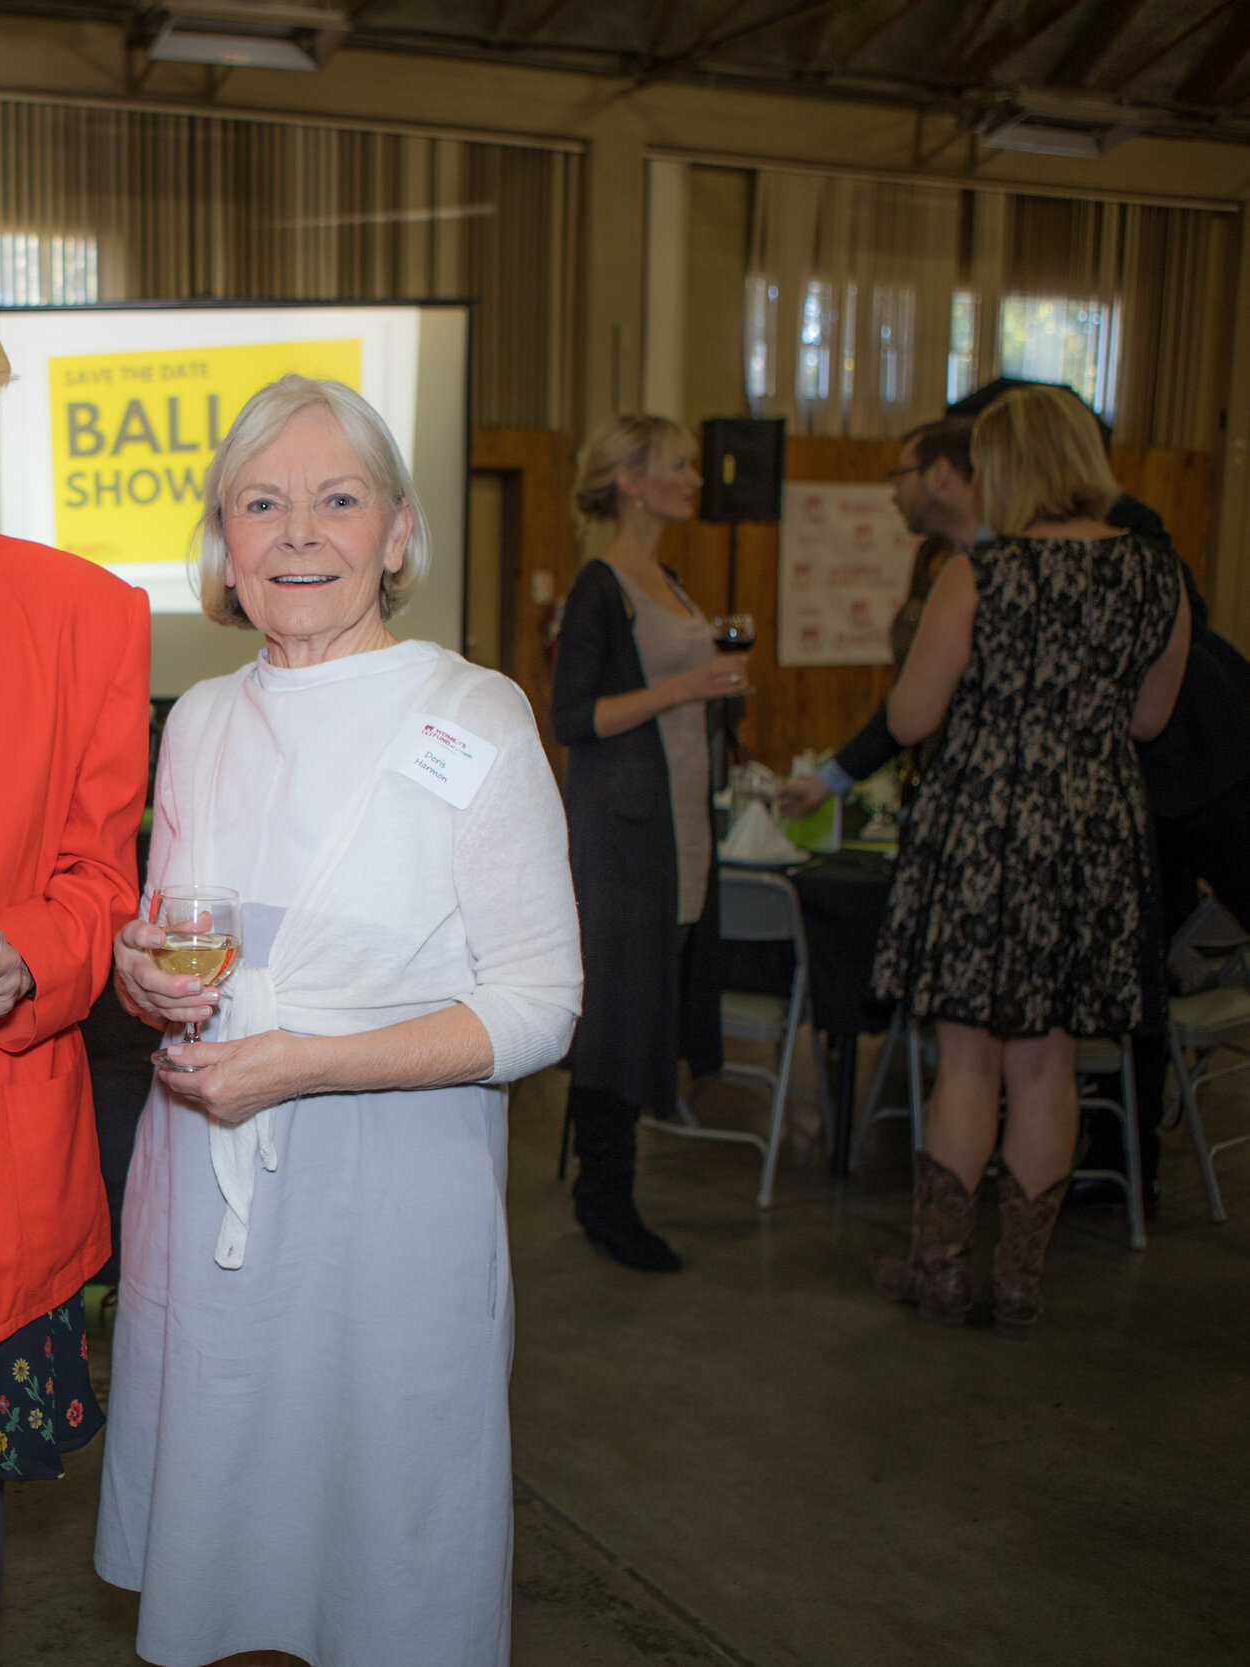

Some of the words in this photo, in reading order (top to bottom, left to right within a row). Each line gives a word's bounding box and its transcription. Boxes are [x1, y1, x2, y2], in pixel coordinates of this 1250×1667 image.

[65, 368, 112, 387] SAVE
[121, 366, 153, 384] THE
[162, 362, 209, 382] DATE
[66, 466, 205, 508] SHOW
[414, 758, 447, 782] Harmon
[425, 751, 446, 768] Doris
